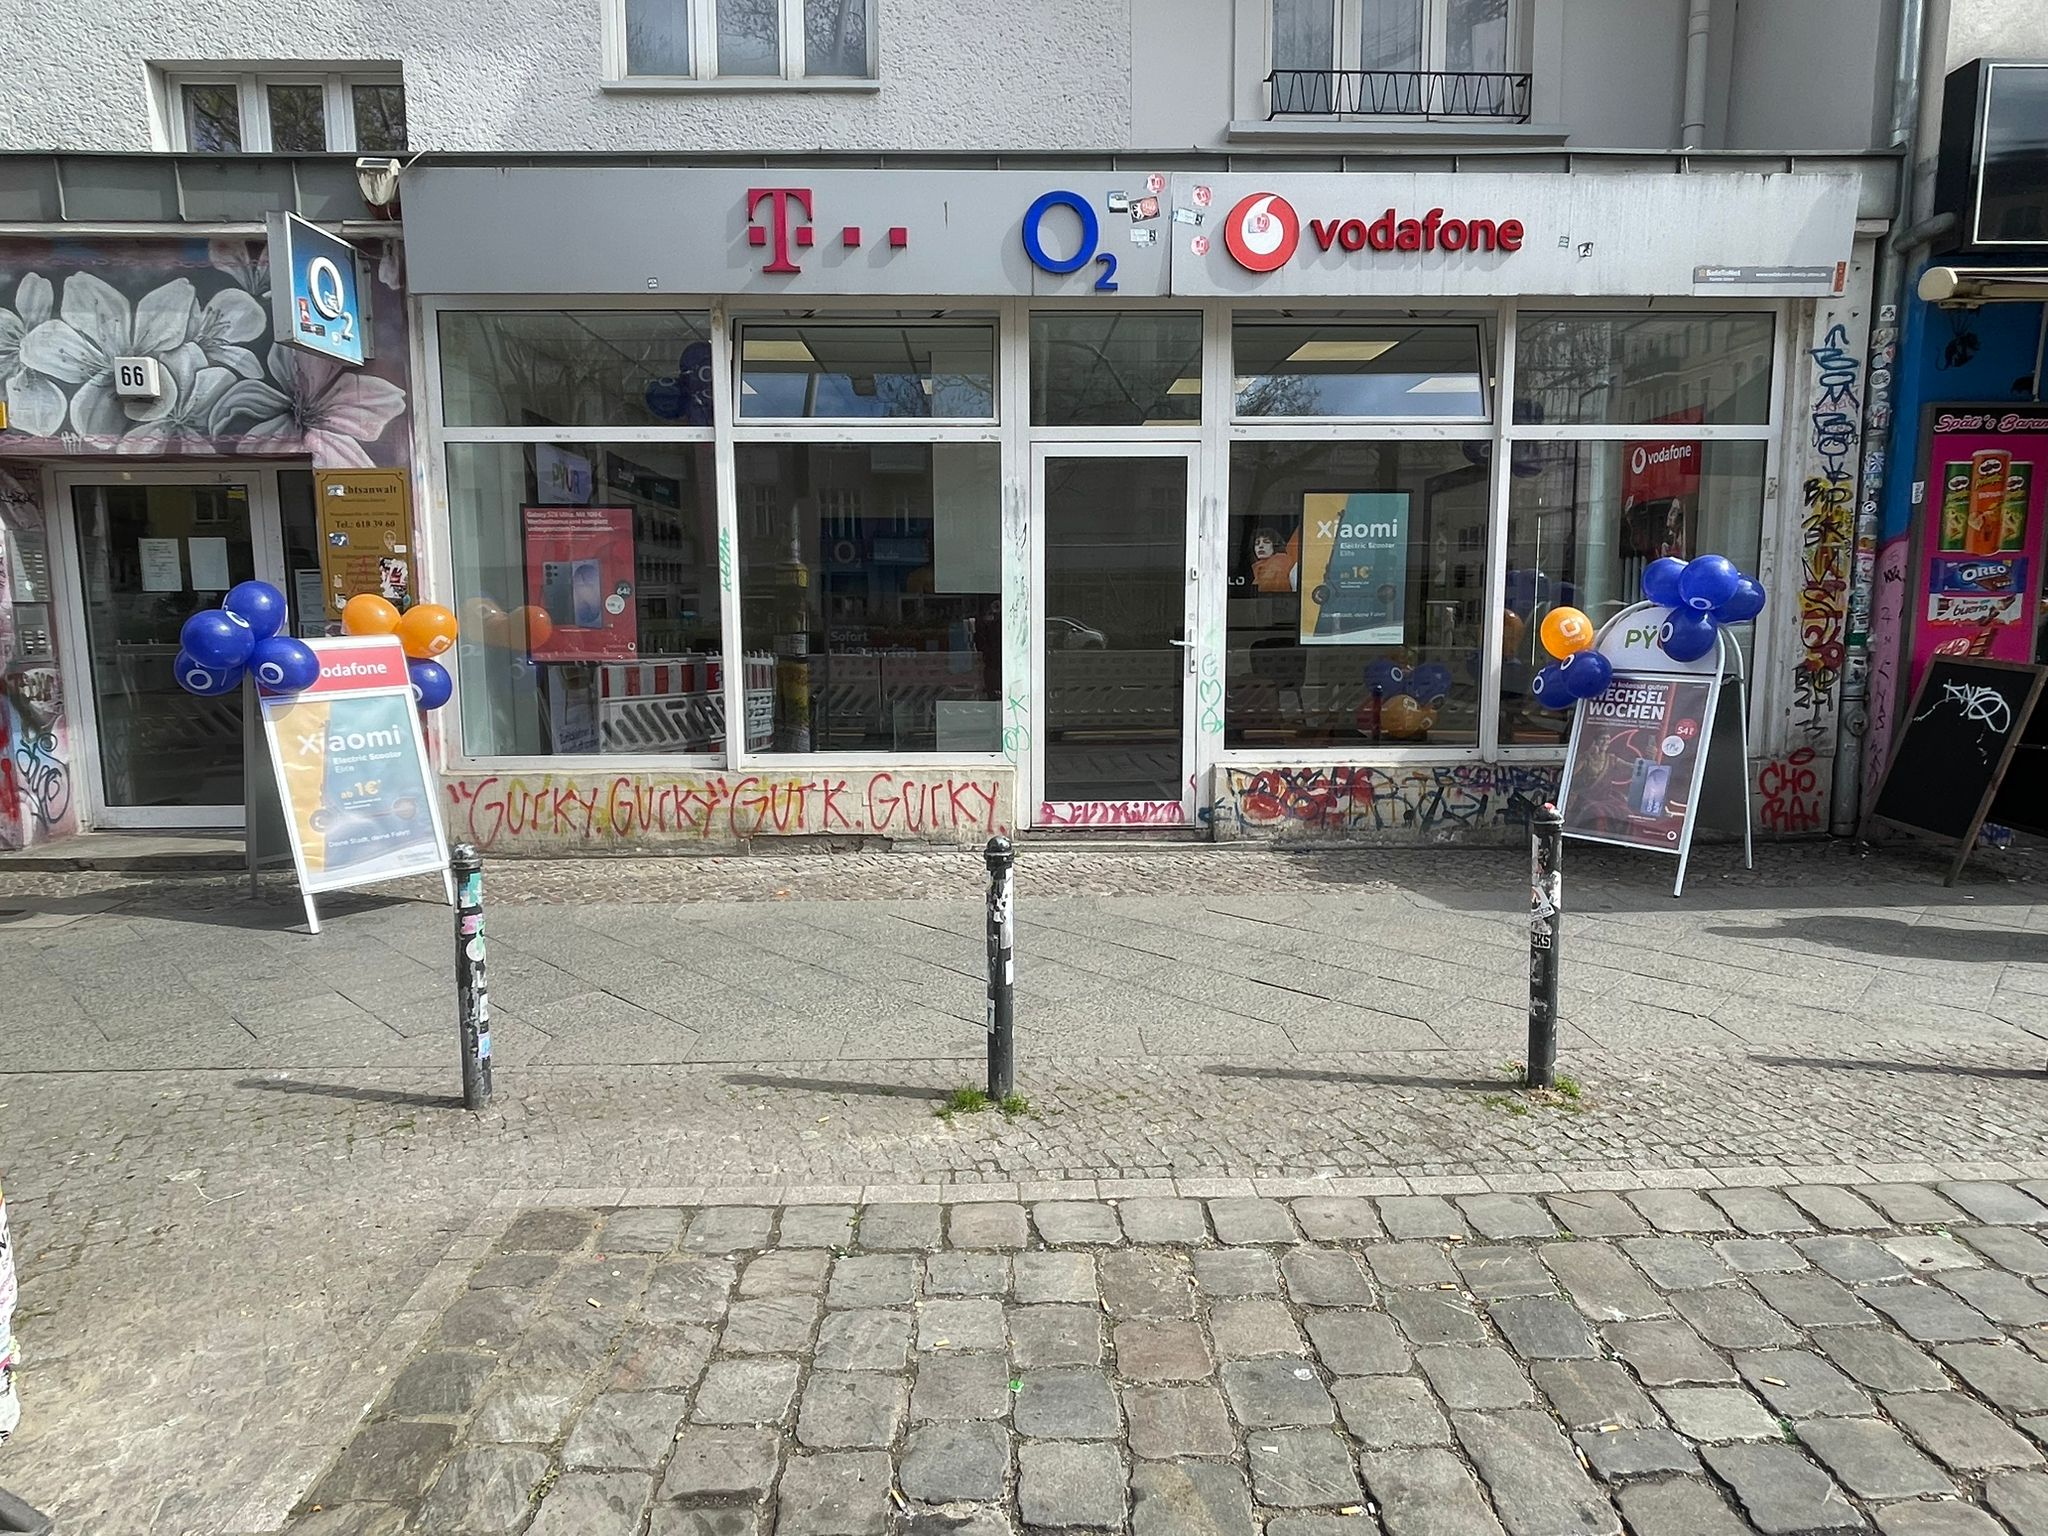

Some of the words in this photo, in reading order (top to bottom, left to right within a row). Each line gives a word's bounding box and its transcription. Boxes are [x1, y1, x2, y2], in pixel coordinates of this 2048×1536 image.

[1311, 208, 1525, 252] vodafone
[121, 365, 144, 386] 66
[1647, 445, 1692, 464] vodafone
[1316, 518, 1398, 539] Xiaomi
[1962, 565, 2007, 581] OREO
[1953, 604, 1989, 617] bueno
[1624, 625, 1662, 650] PŸ
[320, 662, 387, 677] odafone
[1588, 701, 1666, 721] WOCHEN
